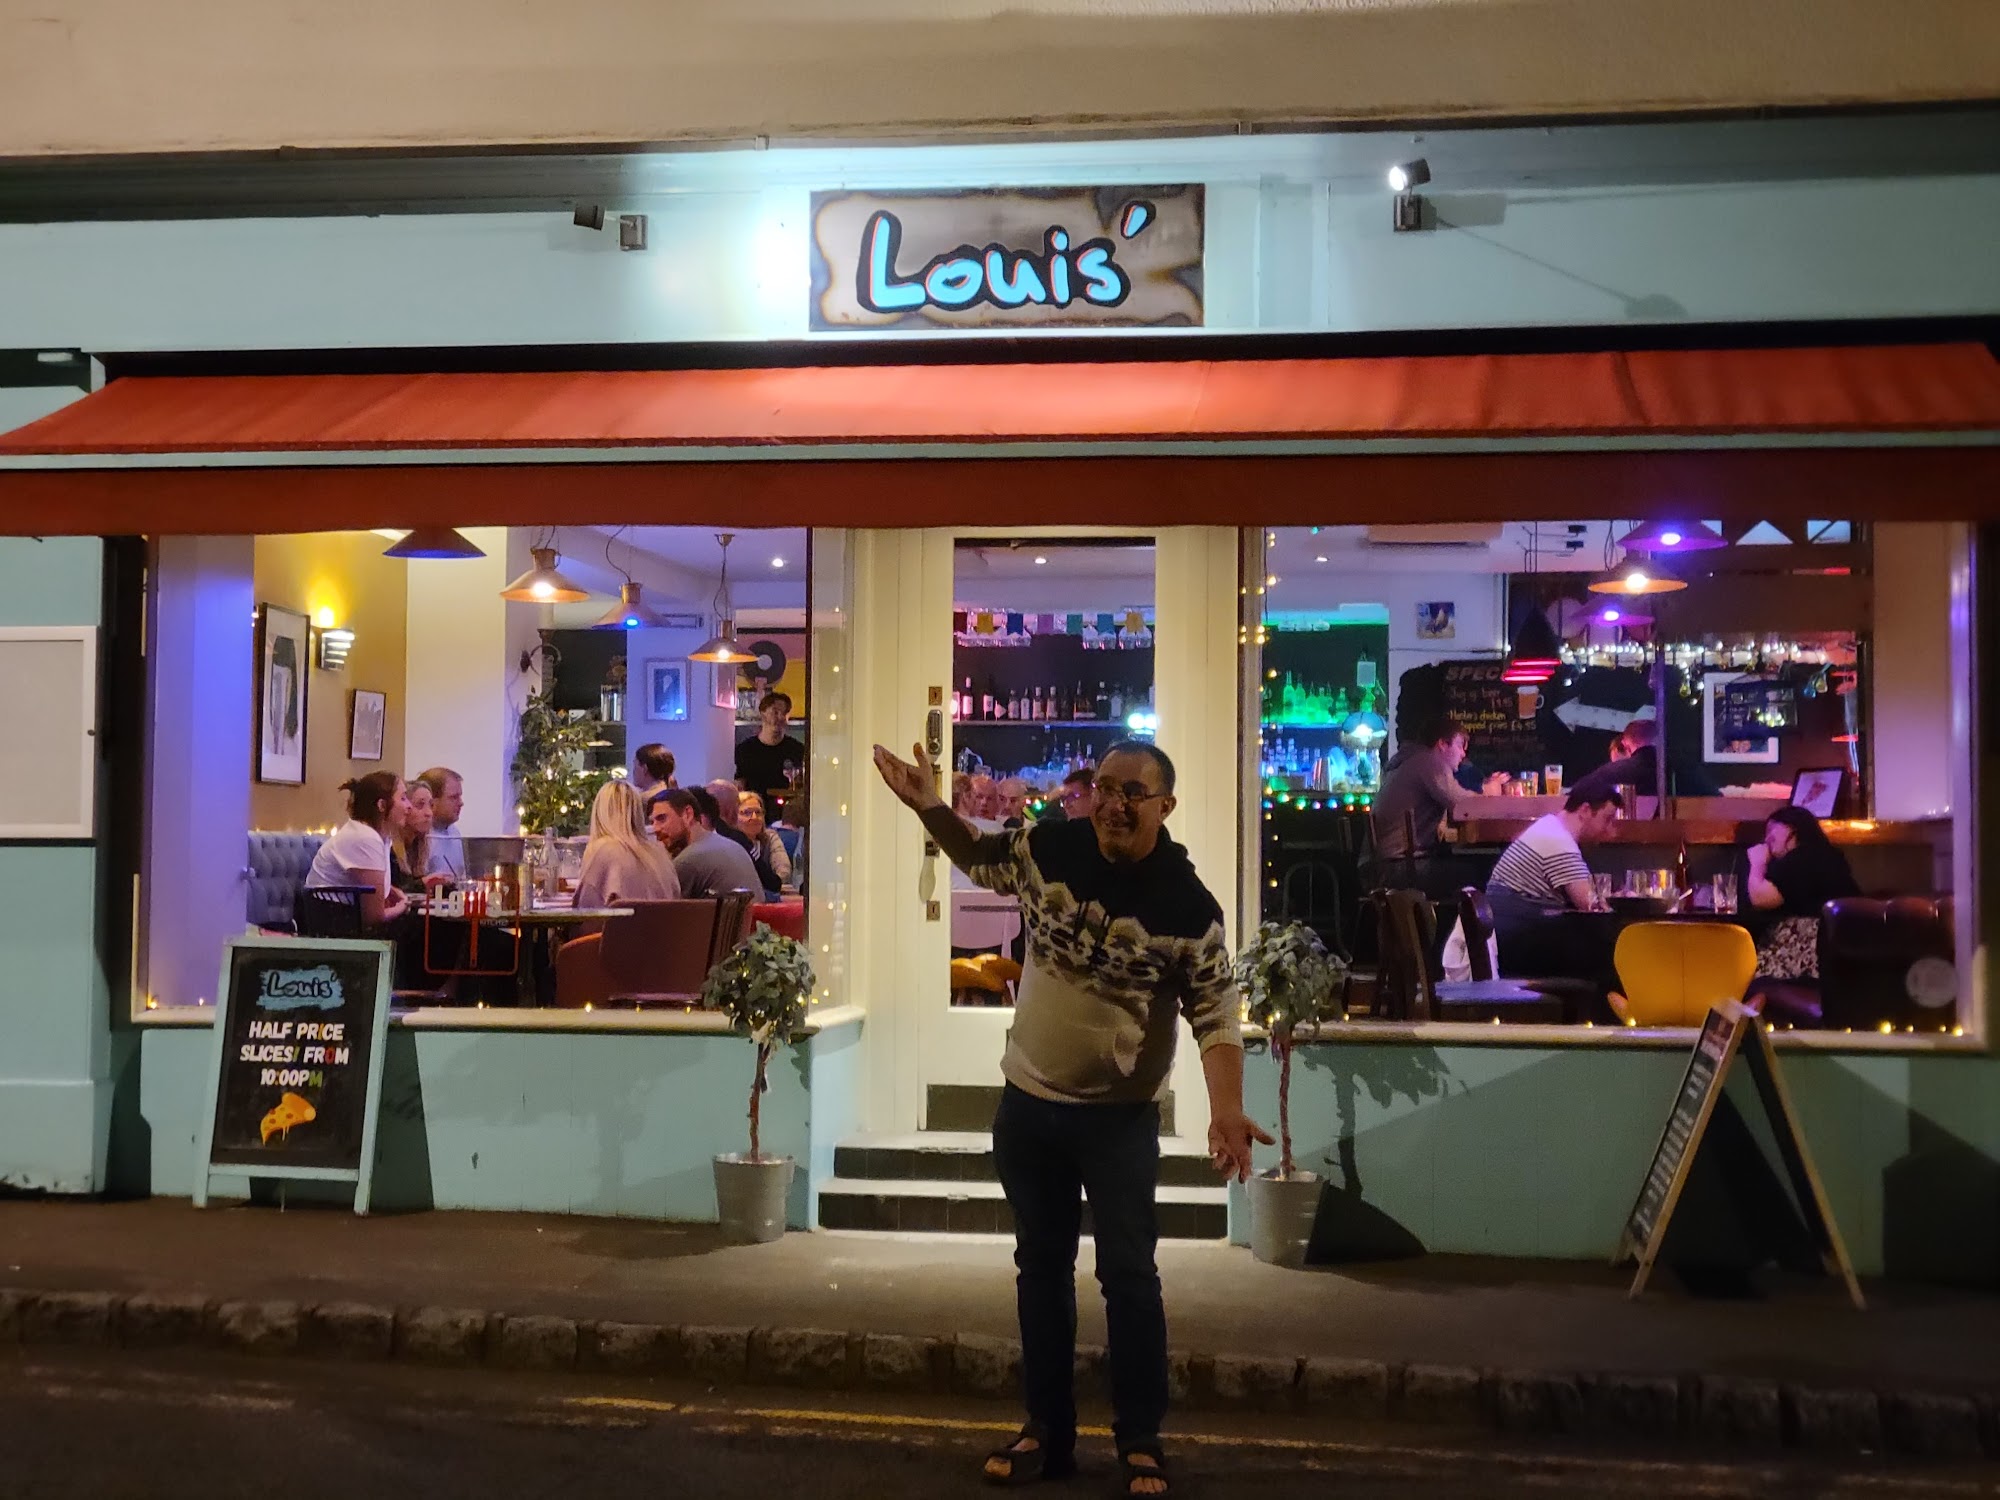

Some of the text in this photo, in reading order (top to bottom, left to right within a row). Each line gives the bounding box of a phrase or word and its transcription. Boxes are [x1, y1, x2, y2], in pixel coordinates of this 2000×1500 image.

[860, 203, 1153, 311] Louis'
[1445, 666, 1501, 681] SPEC
[267, 971, 337, 998] Louis'
[248, 1020, 345, 1041] HALF PRICE
[239, 1044, 349, 1065] SLICES! FROM
[260, 1068, 323, 1087] 10:00PM
